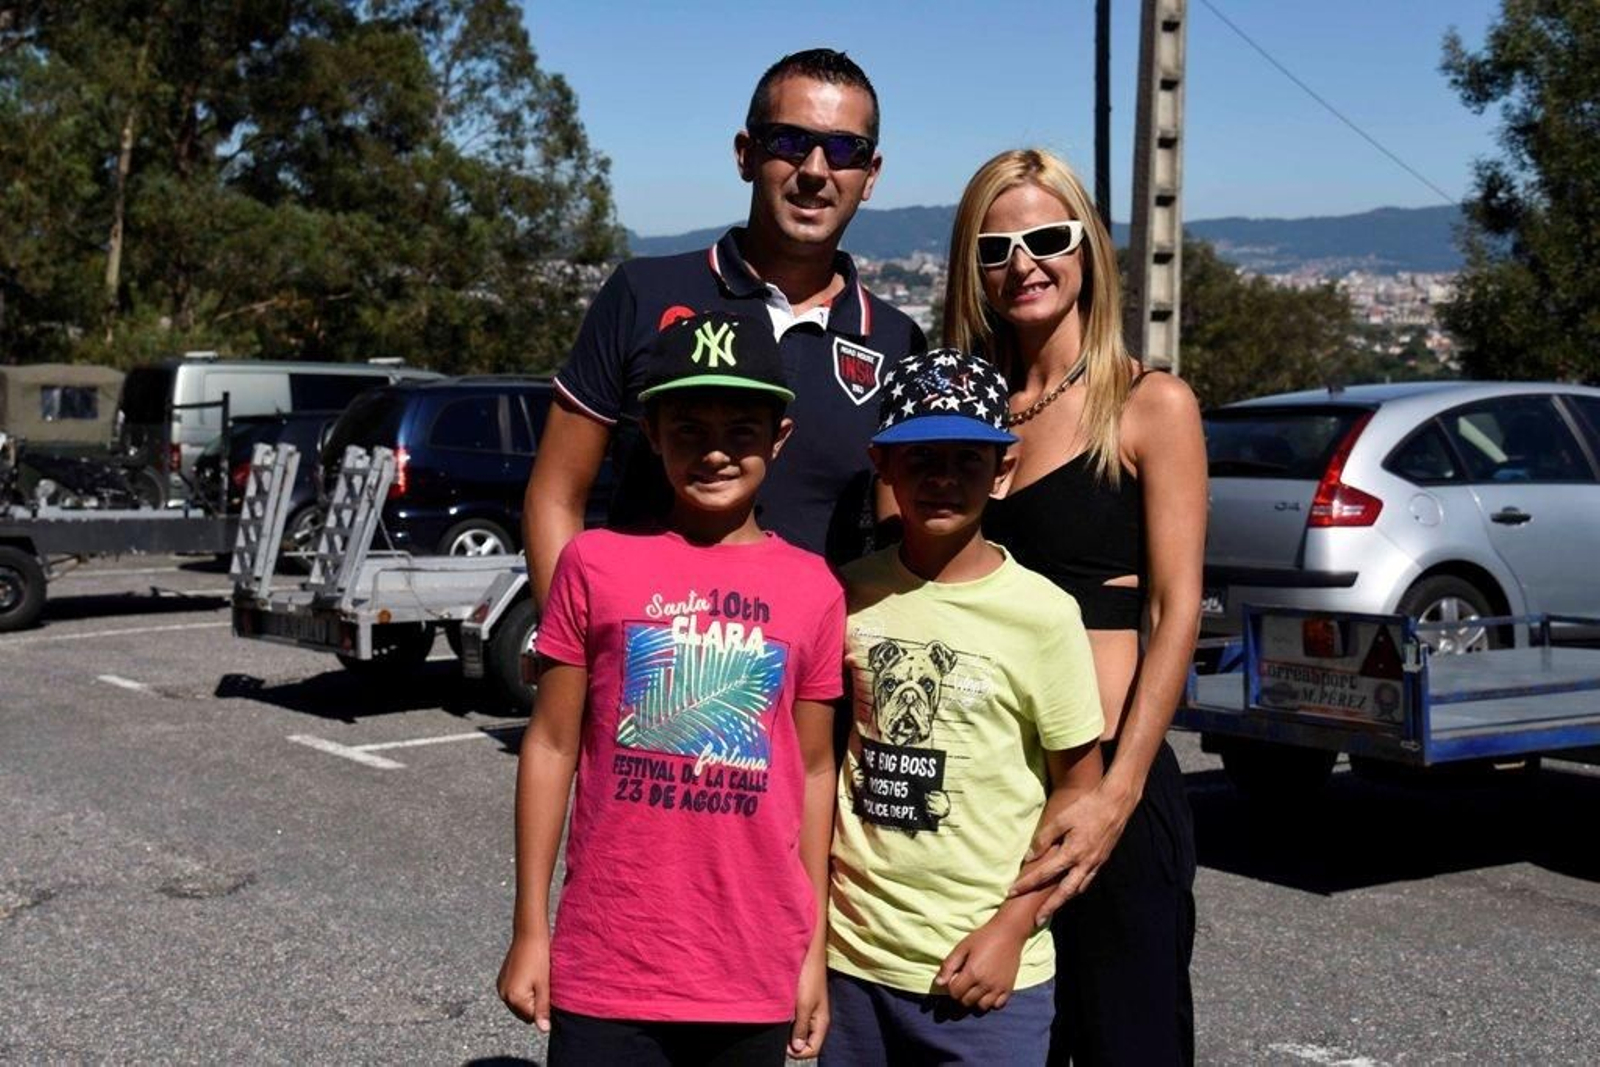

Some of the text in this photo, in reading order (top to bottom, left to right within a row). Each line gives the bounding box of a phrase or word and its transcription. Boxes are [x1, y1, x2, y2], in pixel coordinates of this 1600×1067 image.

[691, 321, 737, 367] NY
[647, 589, 770, 623] Santa 10th
[672, 615, 766, 658] CLARA
[613, 754, 675, 782] FESTIVAL
[705, 768, 724, 788] LA
[728, 770, 768, 792] CALLE
[878, 752, 898, 772] BIG
[900, 754, 937, 778] BOSS
[614, 779, 758, 816] 23 DE AGOSTO
[889, 804, 918, 820] DEPT.
